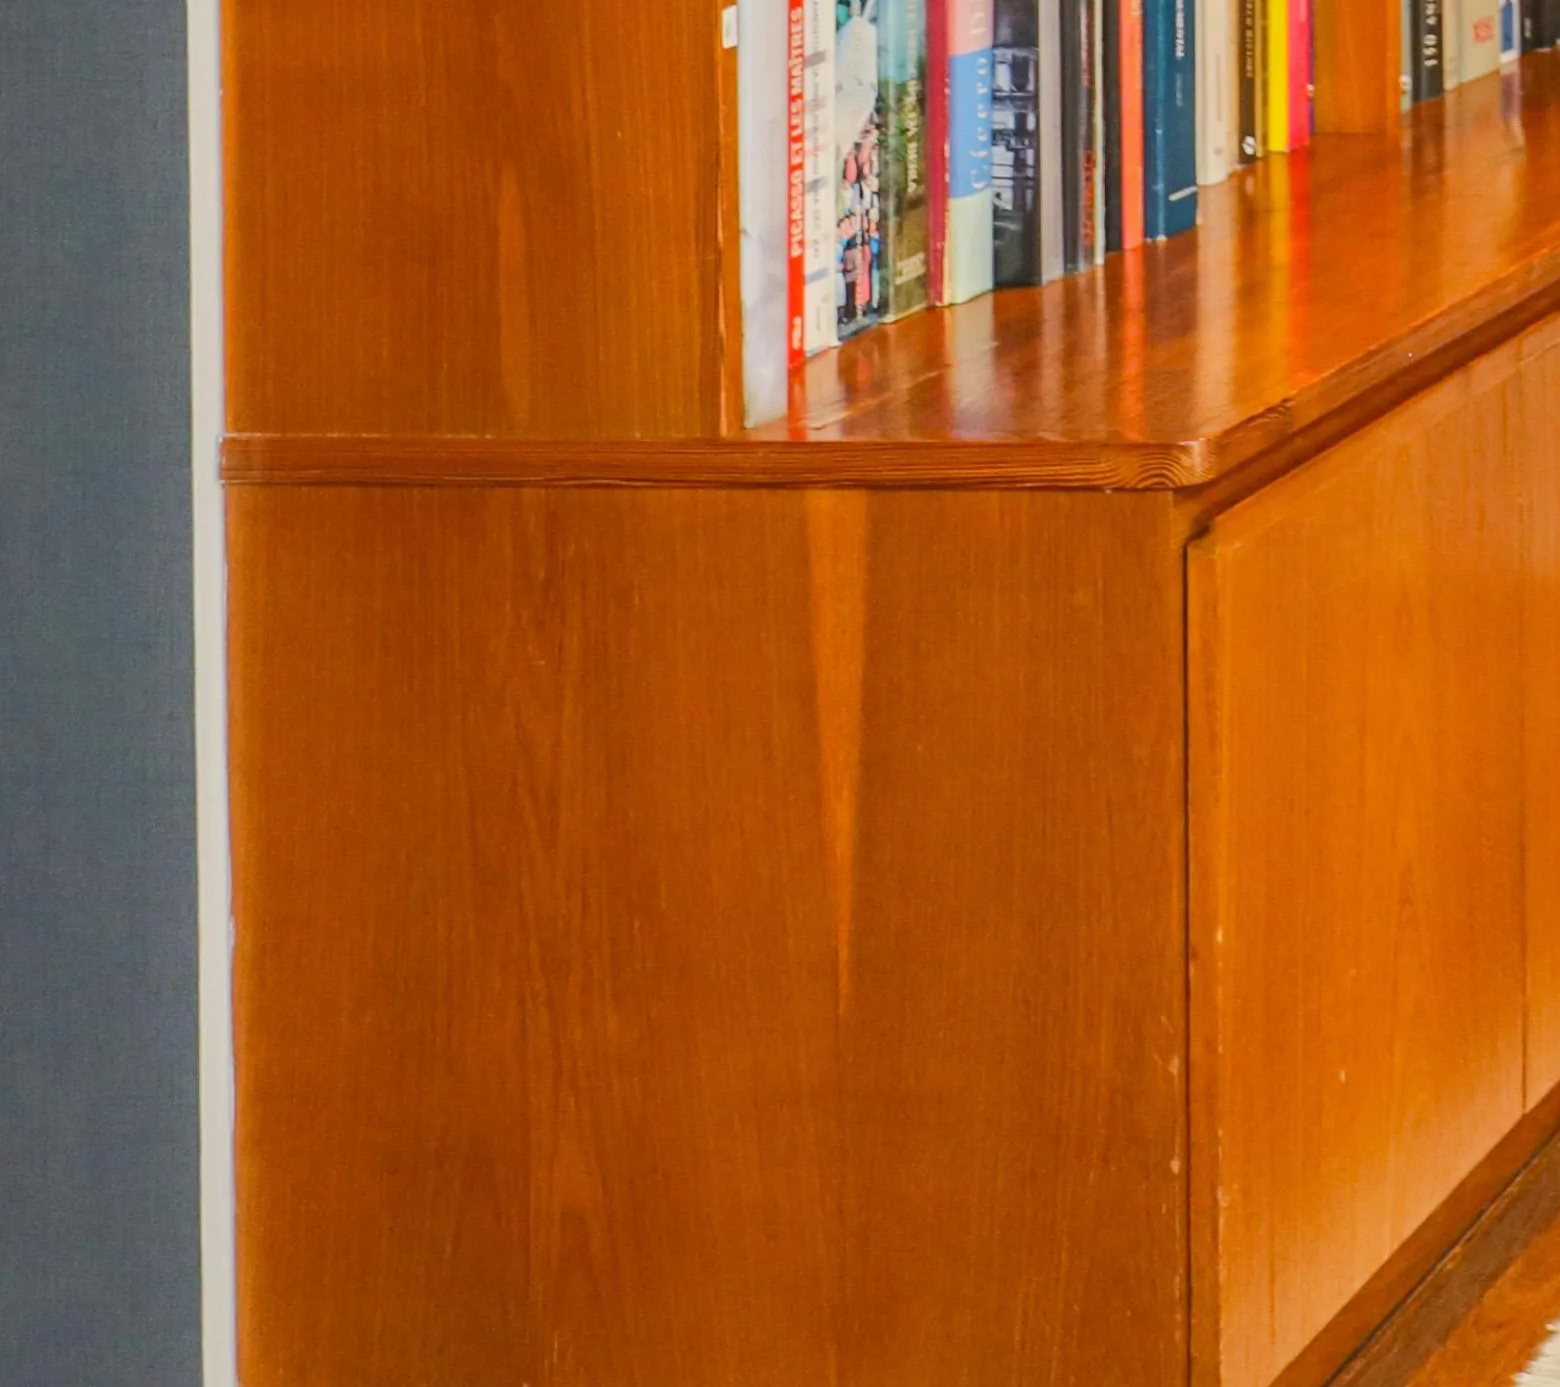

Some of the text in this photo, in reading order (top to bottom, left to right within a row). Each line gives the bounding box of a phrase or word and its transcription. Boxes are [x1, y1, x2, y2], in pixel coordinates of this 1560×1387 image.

[1423, 34, 1440, 67] 150
[789, 100, 803, 137] LES
[789, 142, 803, 164] ET
[789, 170, 803, 257] PICASSO
